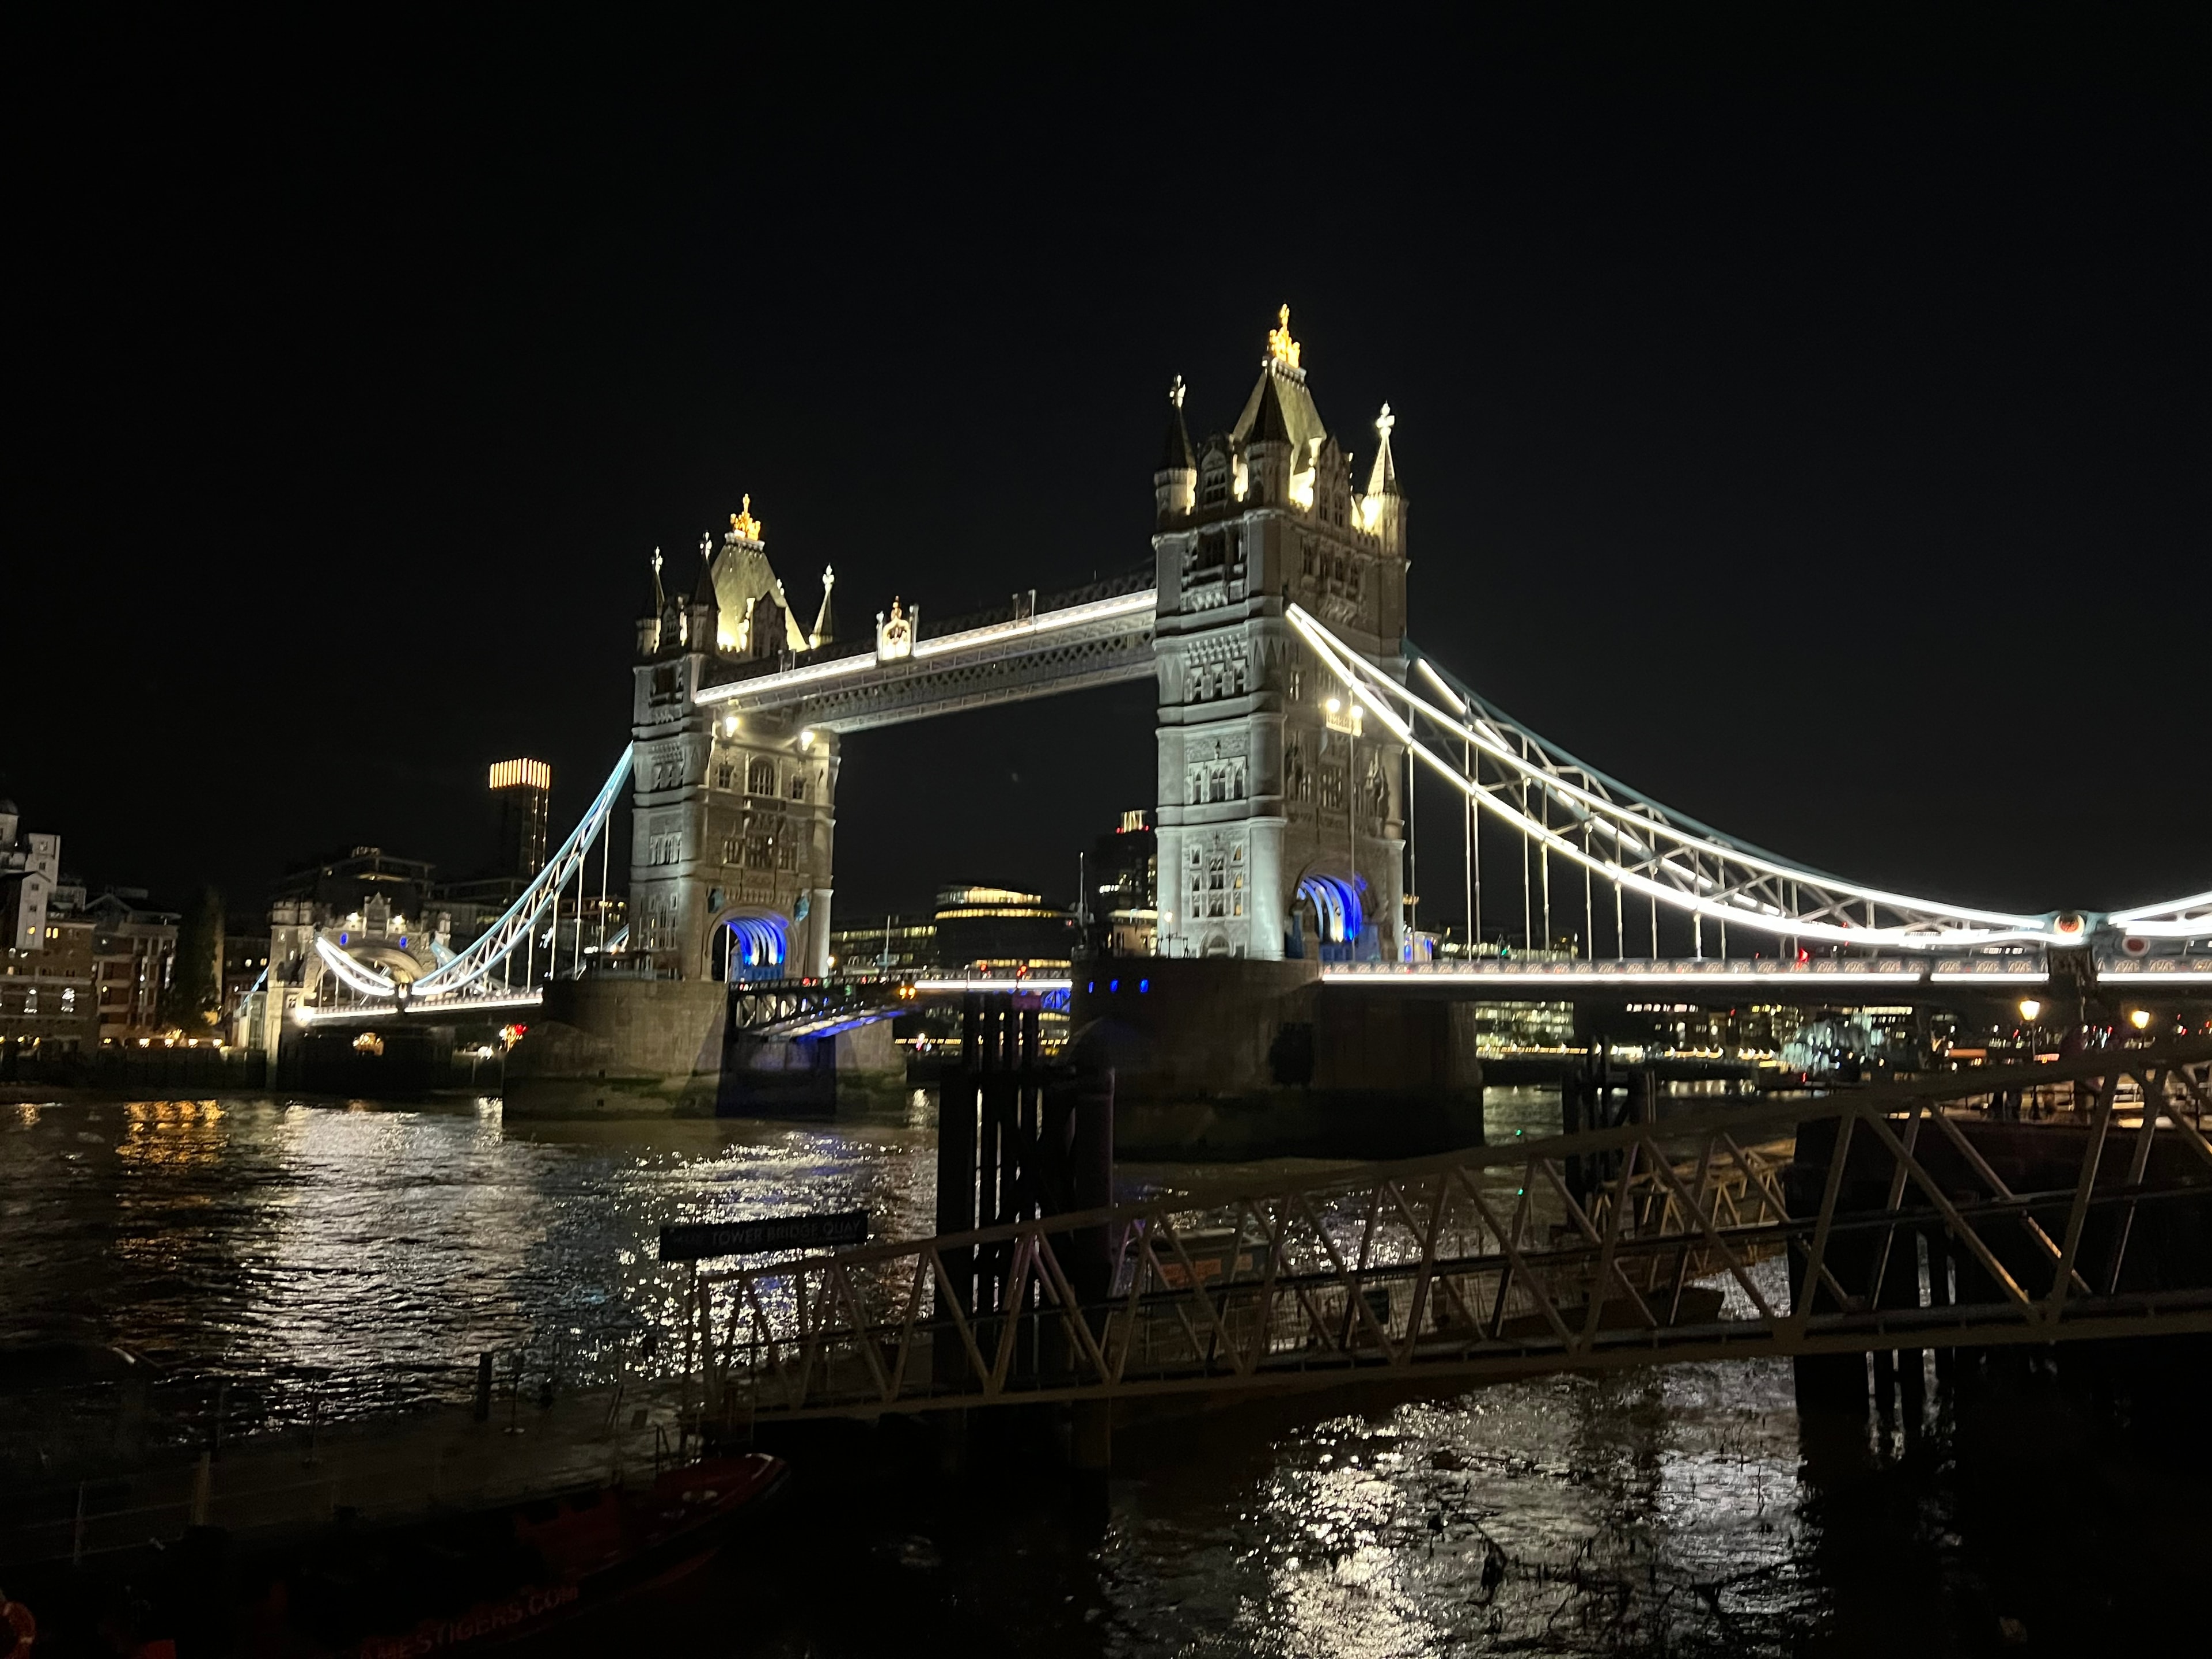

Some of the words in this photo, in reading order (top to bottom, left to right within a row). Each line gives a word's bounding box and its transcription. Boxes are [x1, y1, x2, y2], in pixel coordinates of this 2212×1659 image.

[712, 1227, 763, 1247] TOWER
[767, 1222, 818, 1242] BRIDGE
[823, 1219, 861, 1236] QUAY
